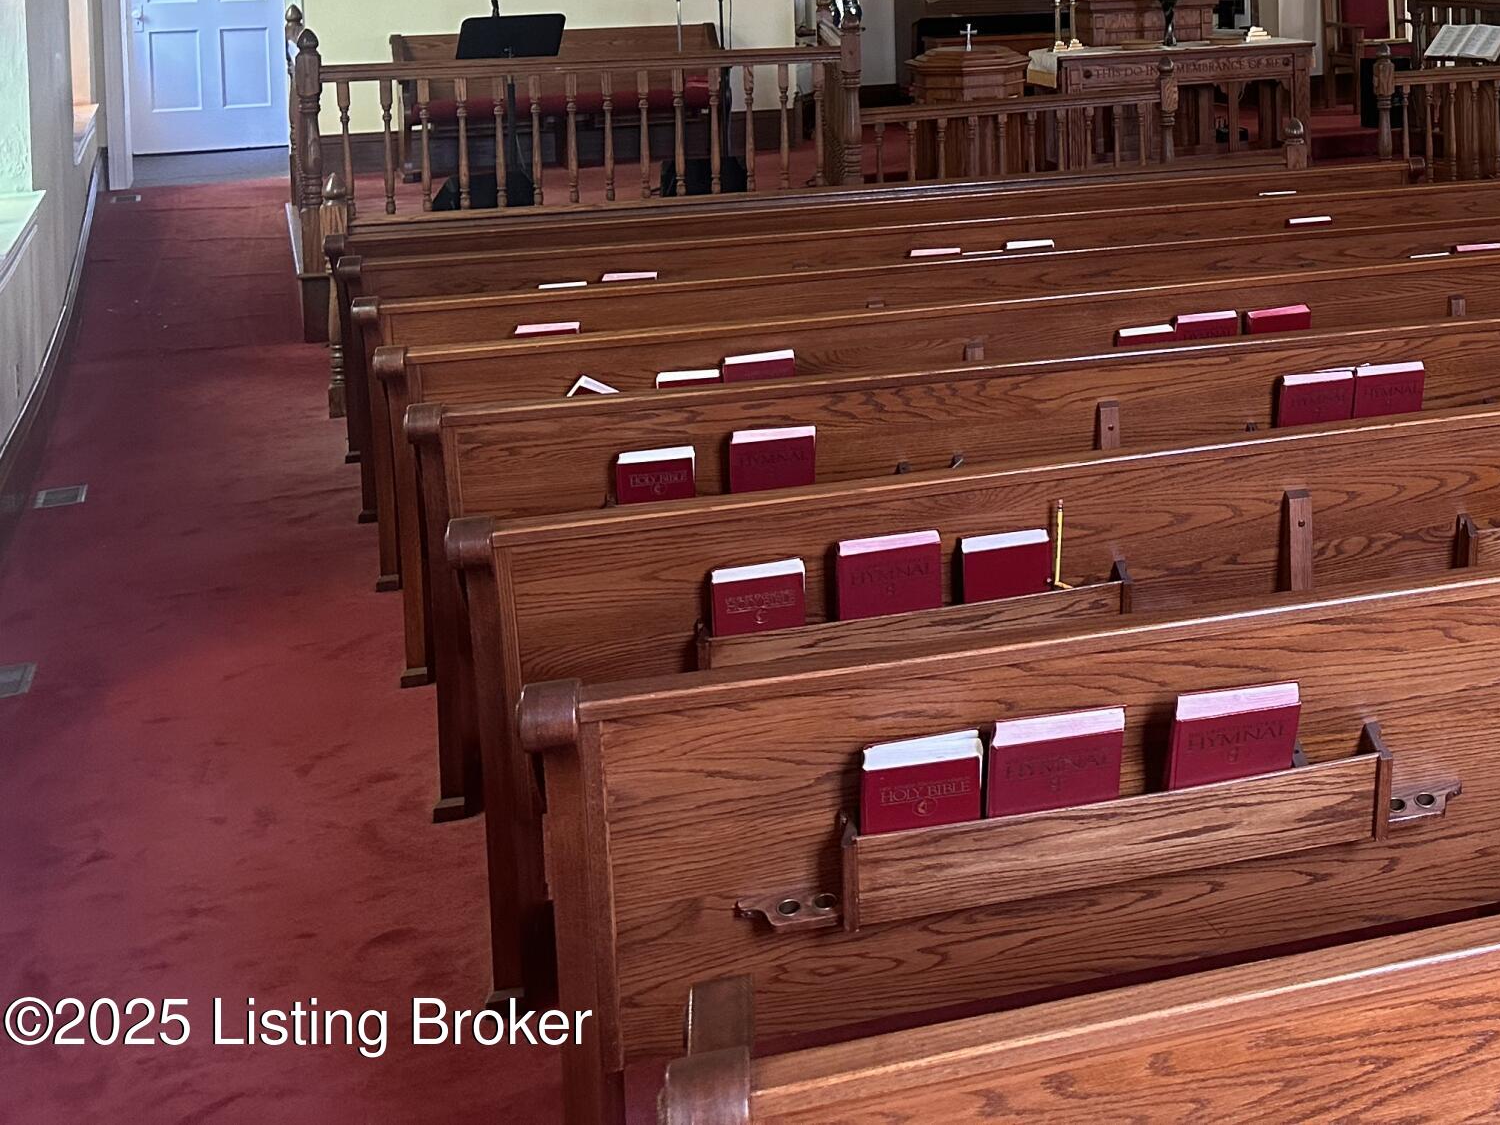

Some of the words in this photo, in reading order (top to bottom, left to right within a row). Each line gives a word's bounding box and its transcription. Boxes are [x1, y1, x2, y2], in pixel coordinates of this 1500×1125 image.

[1188, 725, 1287, 750] HYMNAL
[881, 787, 923, 803] HOLY
[927, 780, 971, 796] BIBLE
